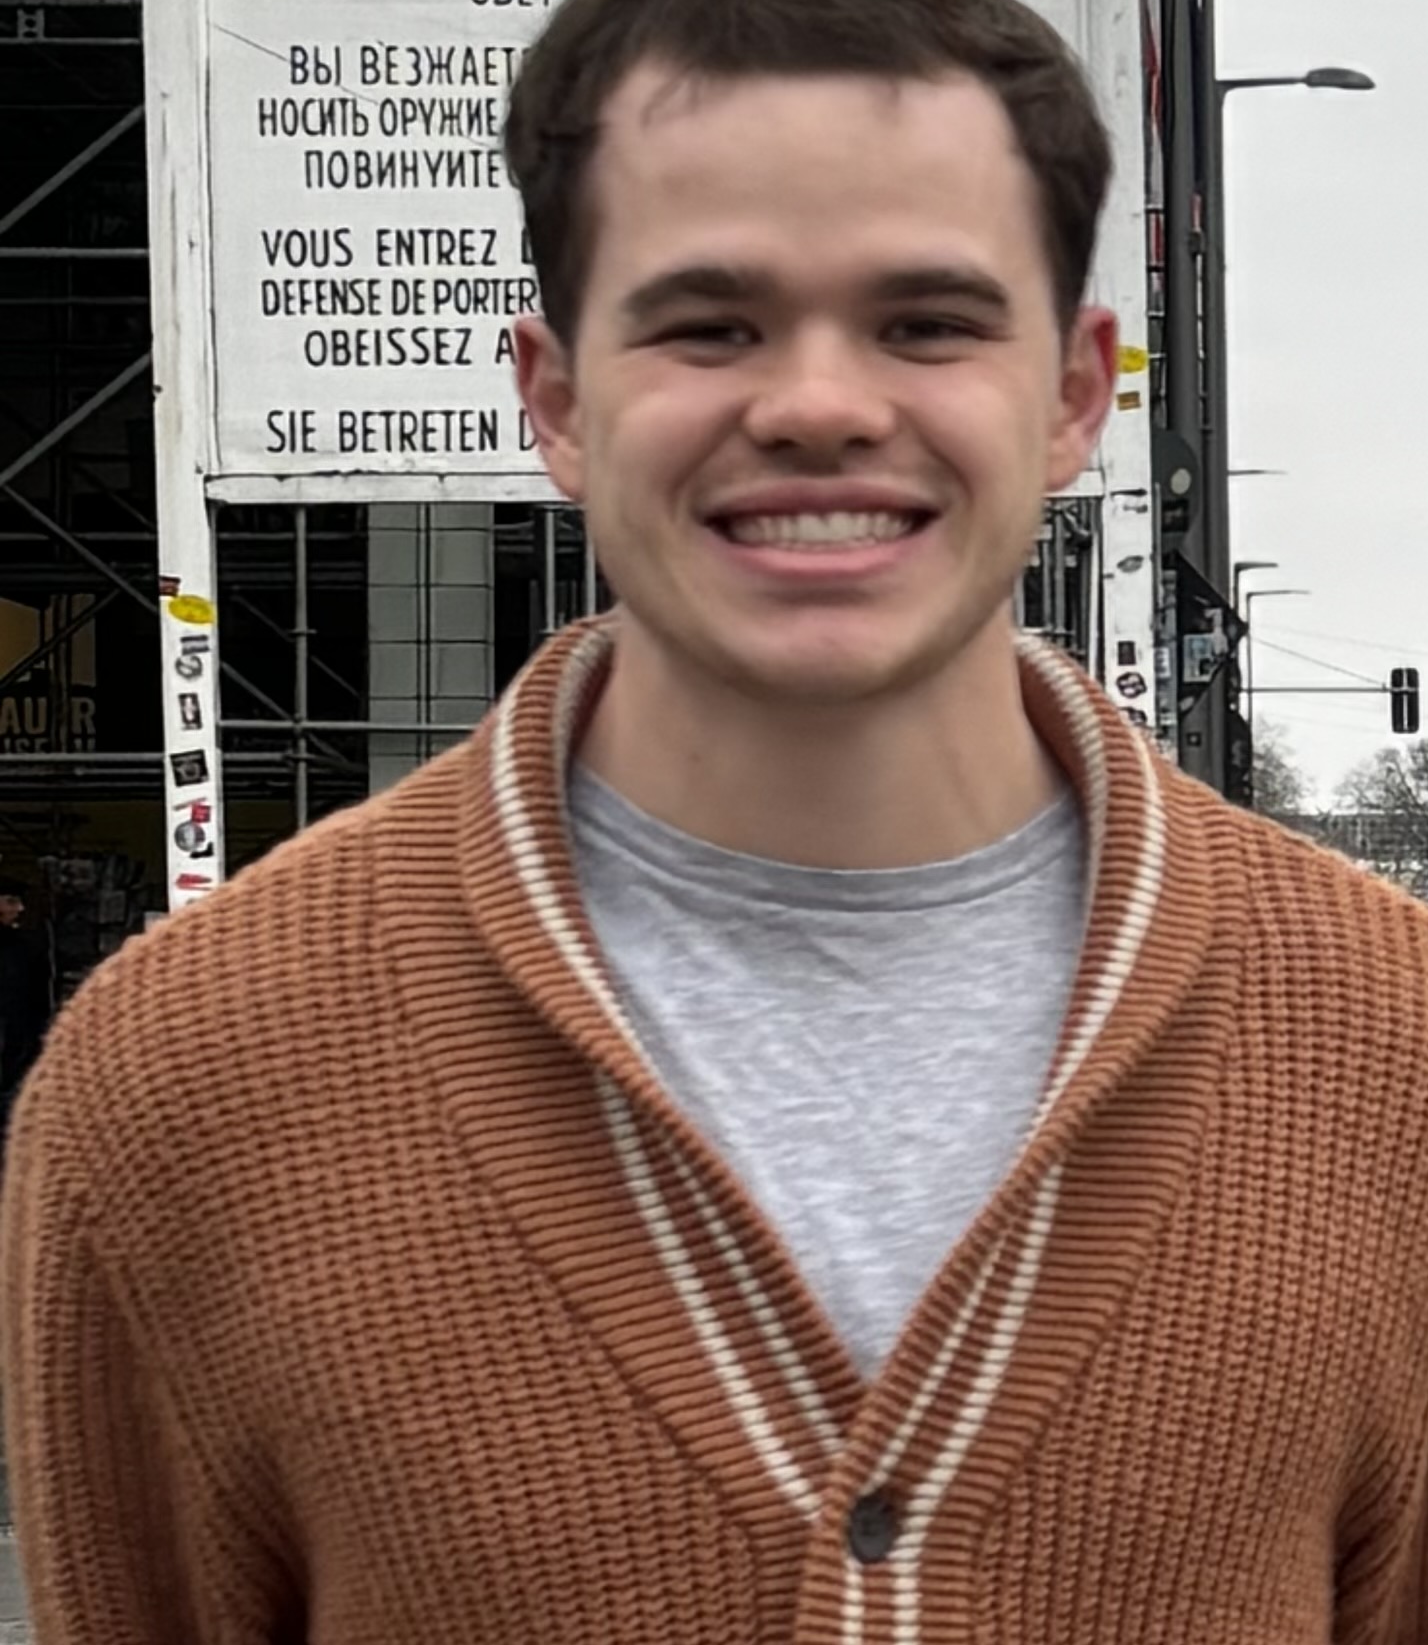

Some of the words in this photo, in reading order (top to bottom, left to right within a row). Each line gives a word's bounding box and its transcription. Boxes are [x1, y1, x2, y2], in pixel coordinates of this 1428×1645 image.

[289, 45, 341, 86] ВЫ
[360, 45, 530, 86] ВЕЗЖАЕТ
[257, 97, 369, 137] НОСИТЬ
[378, 97, 499, 137] ОРУЖИЕ
[261, 228, 353, 268] VOUS
[376, 229, 498, 267] ENTREZ
[261, 279, 382, 316] DEFENSE
[391, 279, 427, 316] DE
[433, 277, 538, 315] PORTER
[304, 328, 473, 367] OBEISSEZ
[265, 409, 317, 454] SIE
[338, 409, 498, 454] BETRETEN
[0, 696, 97, 735] AUR
